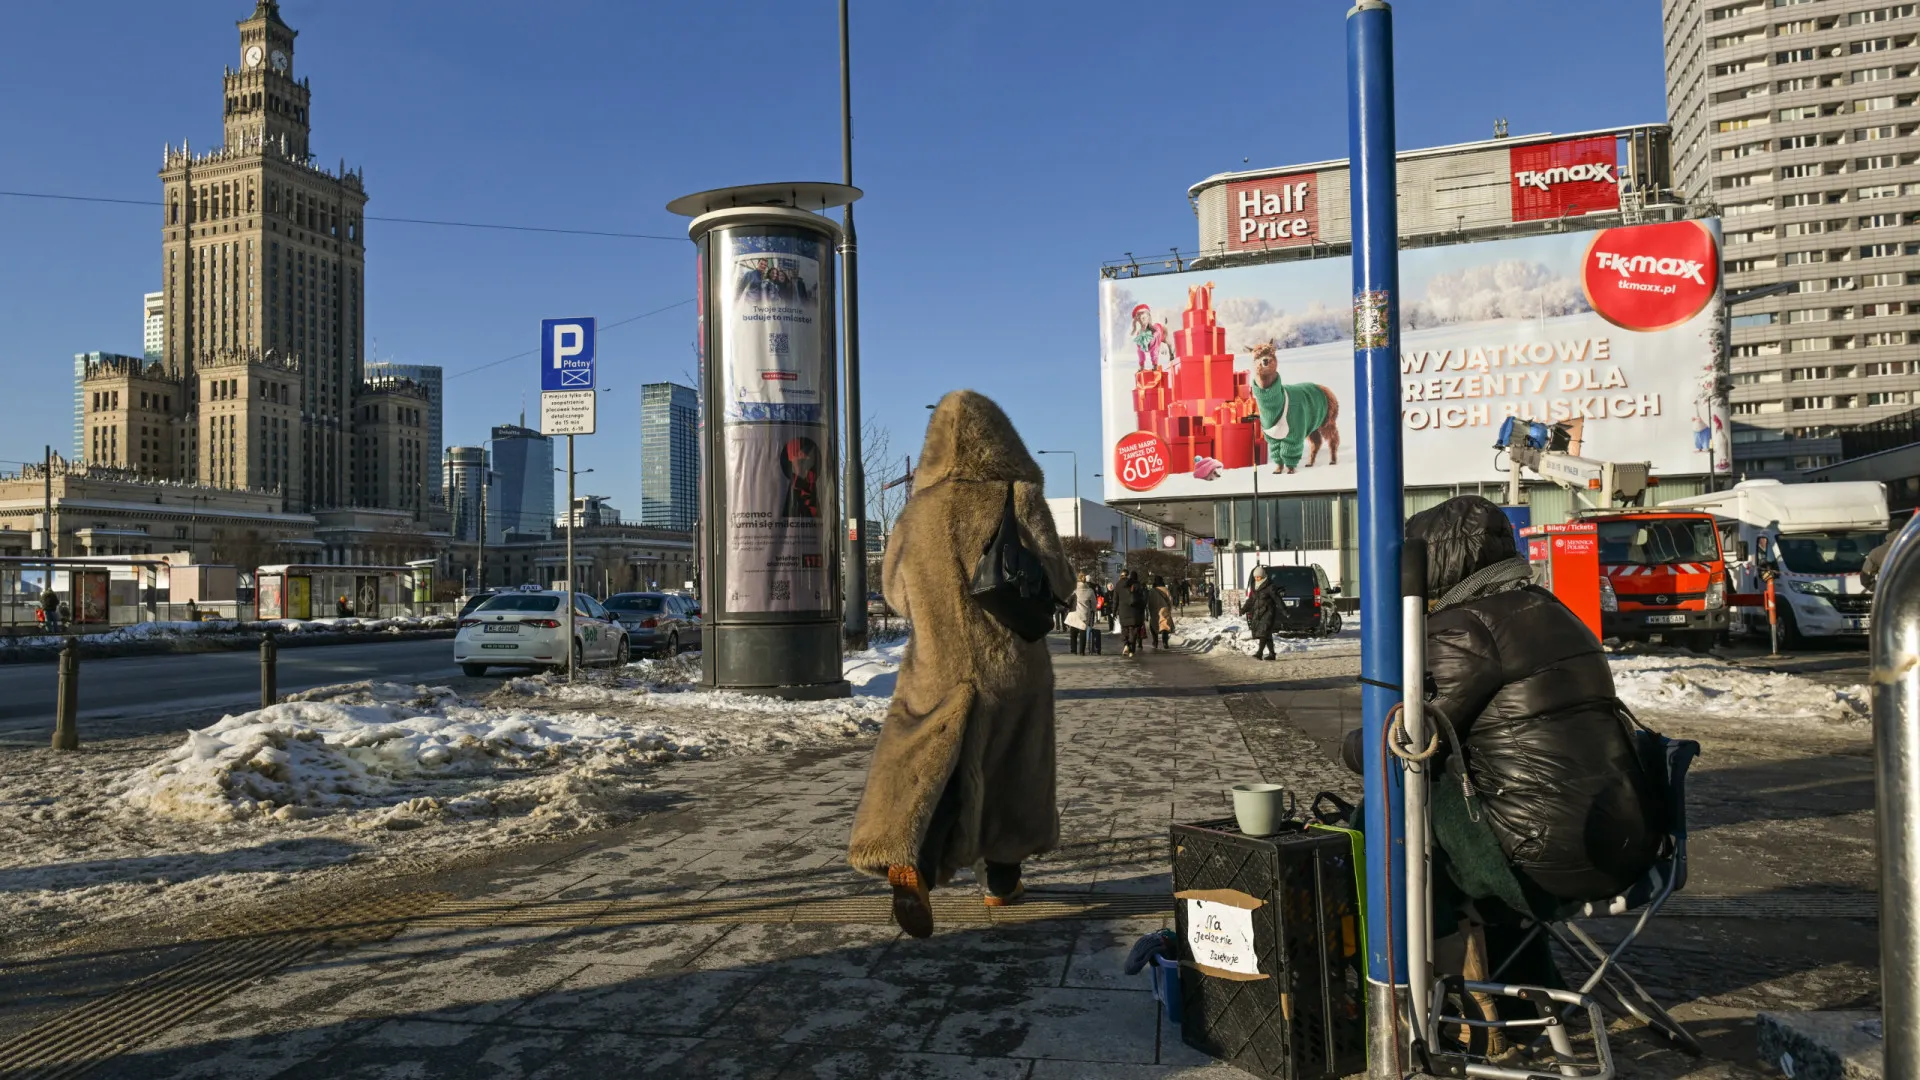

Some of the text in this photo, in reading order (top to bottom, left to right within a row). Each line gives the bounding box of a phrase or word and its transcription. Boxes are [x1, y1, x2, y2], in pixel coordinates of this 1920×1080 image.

[1239, 182, 1308, 217] Half
[1240, 217, 1308, 243] Price
[1617, 280, 1677, 295] tkmaxx.pl
[752, 305, 803, 315] Twoje zdanie
[782, 315, 812, 324] miasto!
[553, 324, 584, 369] P
[563, 359, 591, 369] Płatny
[1401, 338, 1610, 374] WYJĄTKOWE
[1401, 365, 1628, 402] REZENTY DLA
[1123, 453, 1163, 482] 60%
[759, 520, 773, 529] się
[1547, 524, 1567, 532] Bilety
[584, 626, 598, 643] Bolt
[1205, 914, 1222, 931] Na
